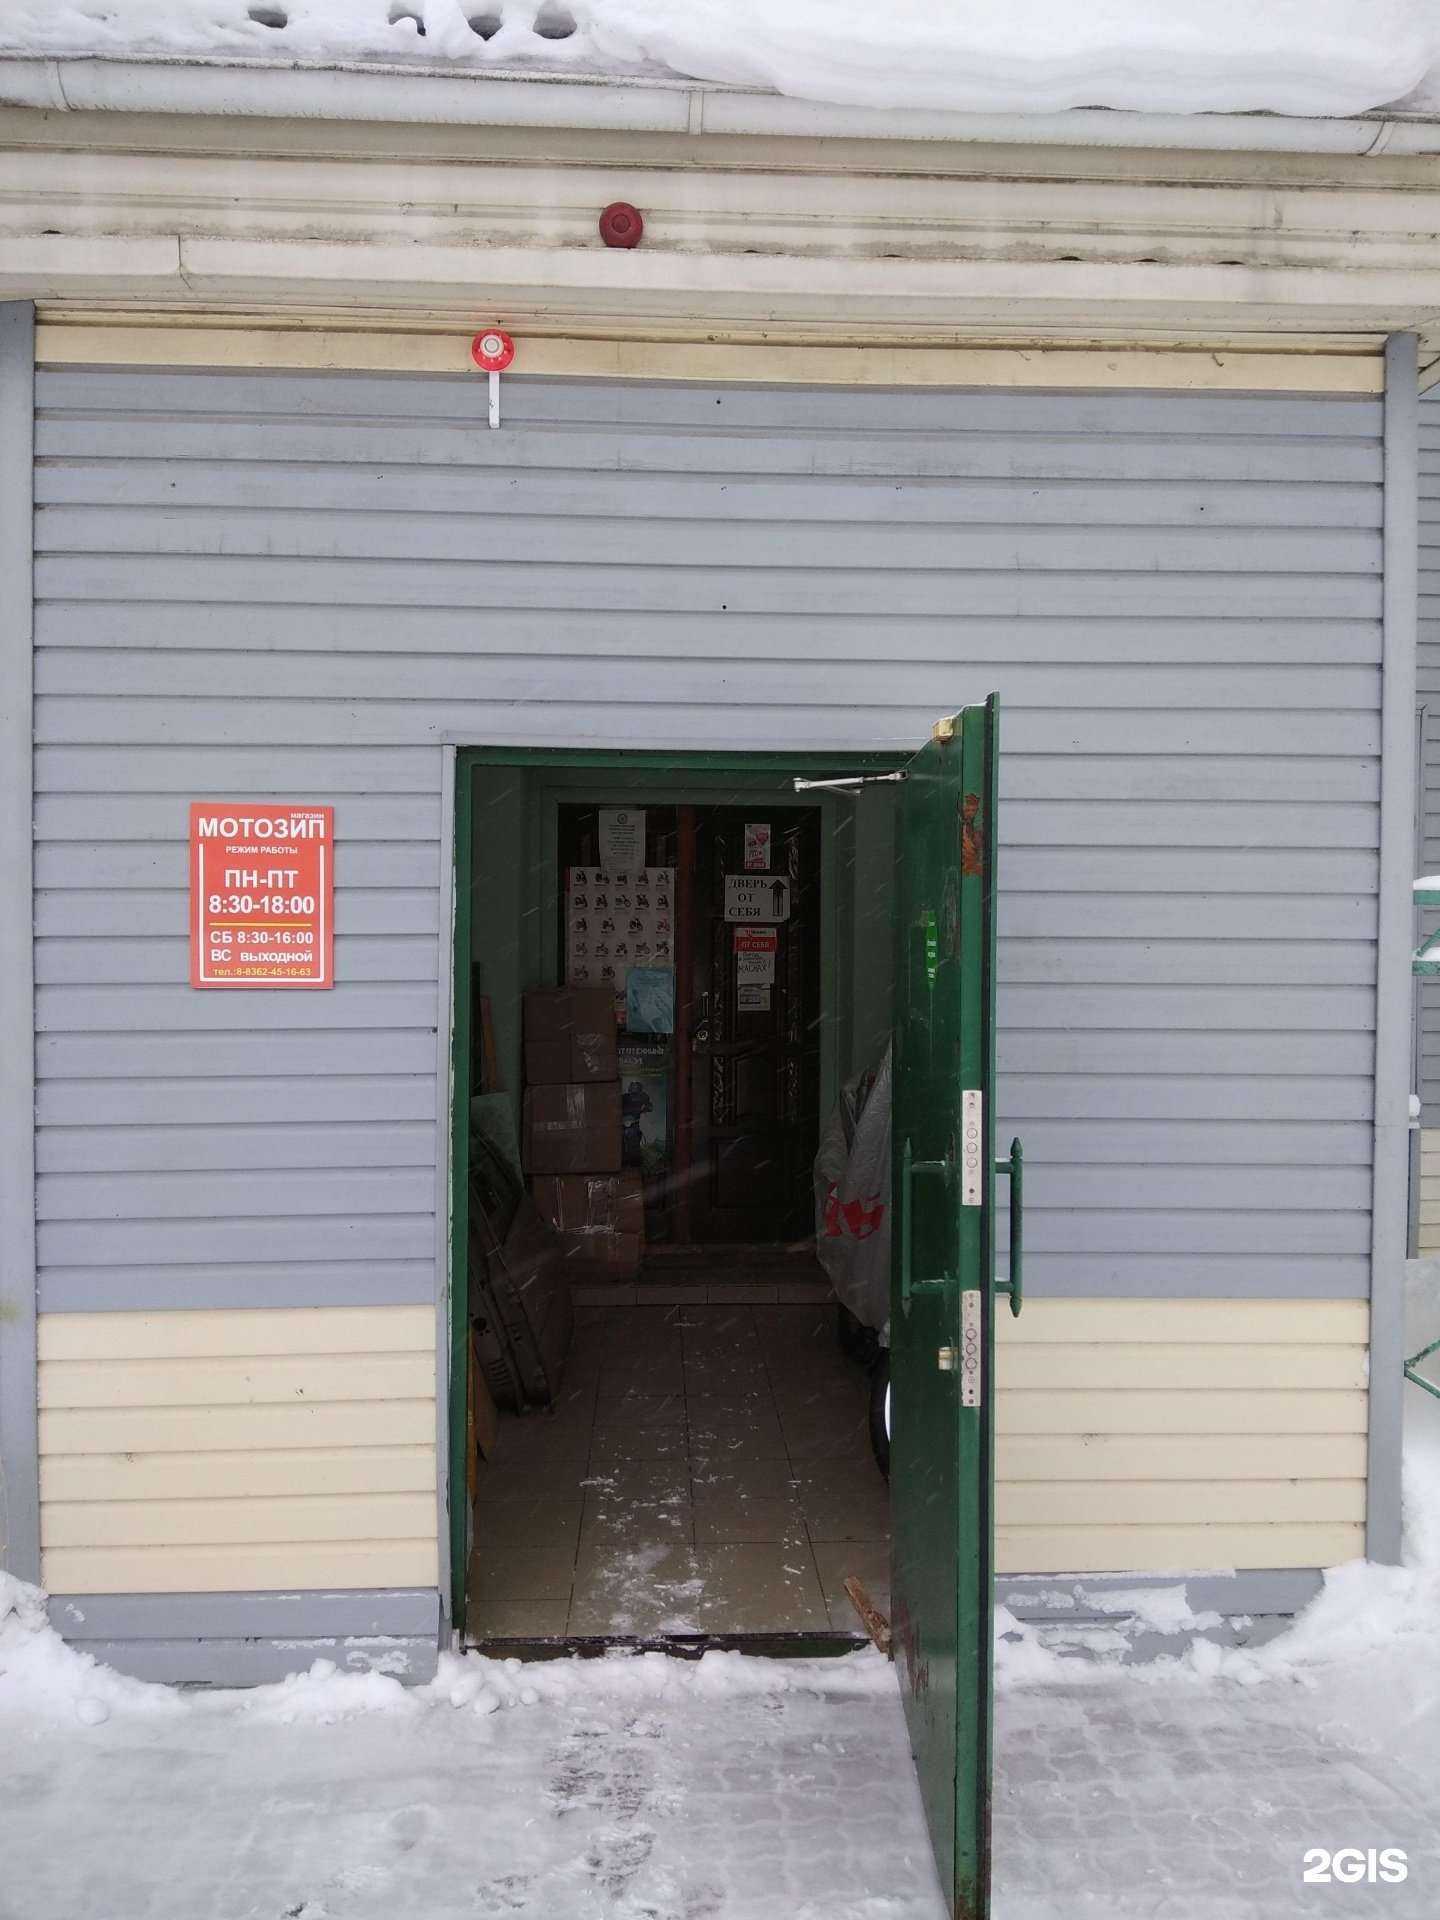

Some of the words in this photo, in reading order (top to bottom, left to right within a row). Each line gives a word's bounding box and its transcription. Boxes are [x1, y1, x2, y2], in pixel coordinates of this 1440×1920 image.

[198, 817, 325, 838] МОТОЗИП
[225, 846, 259, 854] РЕЖИМ
[260, 846, 298, 854] РАБОТЫ
[224, 869, 299, 888] ПН-ПТ
[729, 879, 768, 889] ДВЕРЬ
[738, 893, 755, 902] ОТ
[208, 895, 315, 914] 8:30-18:00
[729, 907, 761, 917] СЕБЯ
[210, 931, 233, 944] СБ
[237, 931, 314, 945] 8:30-16:00
[210, 949, 232, 962] ВС
